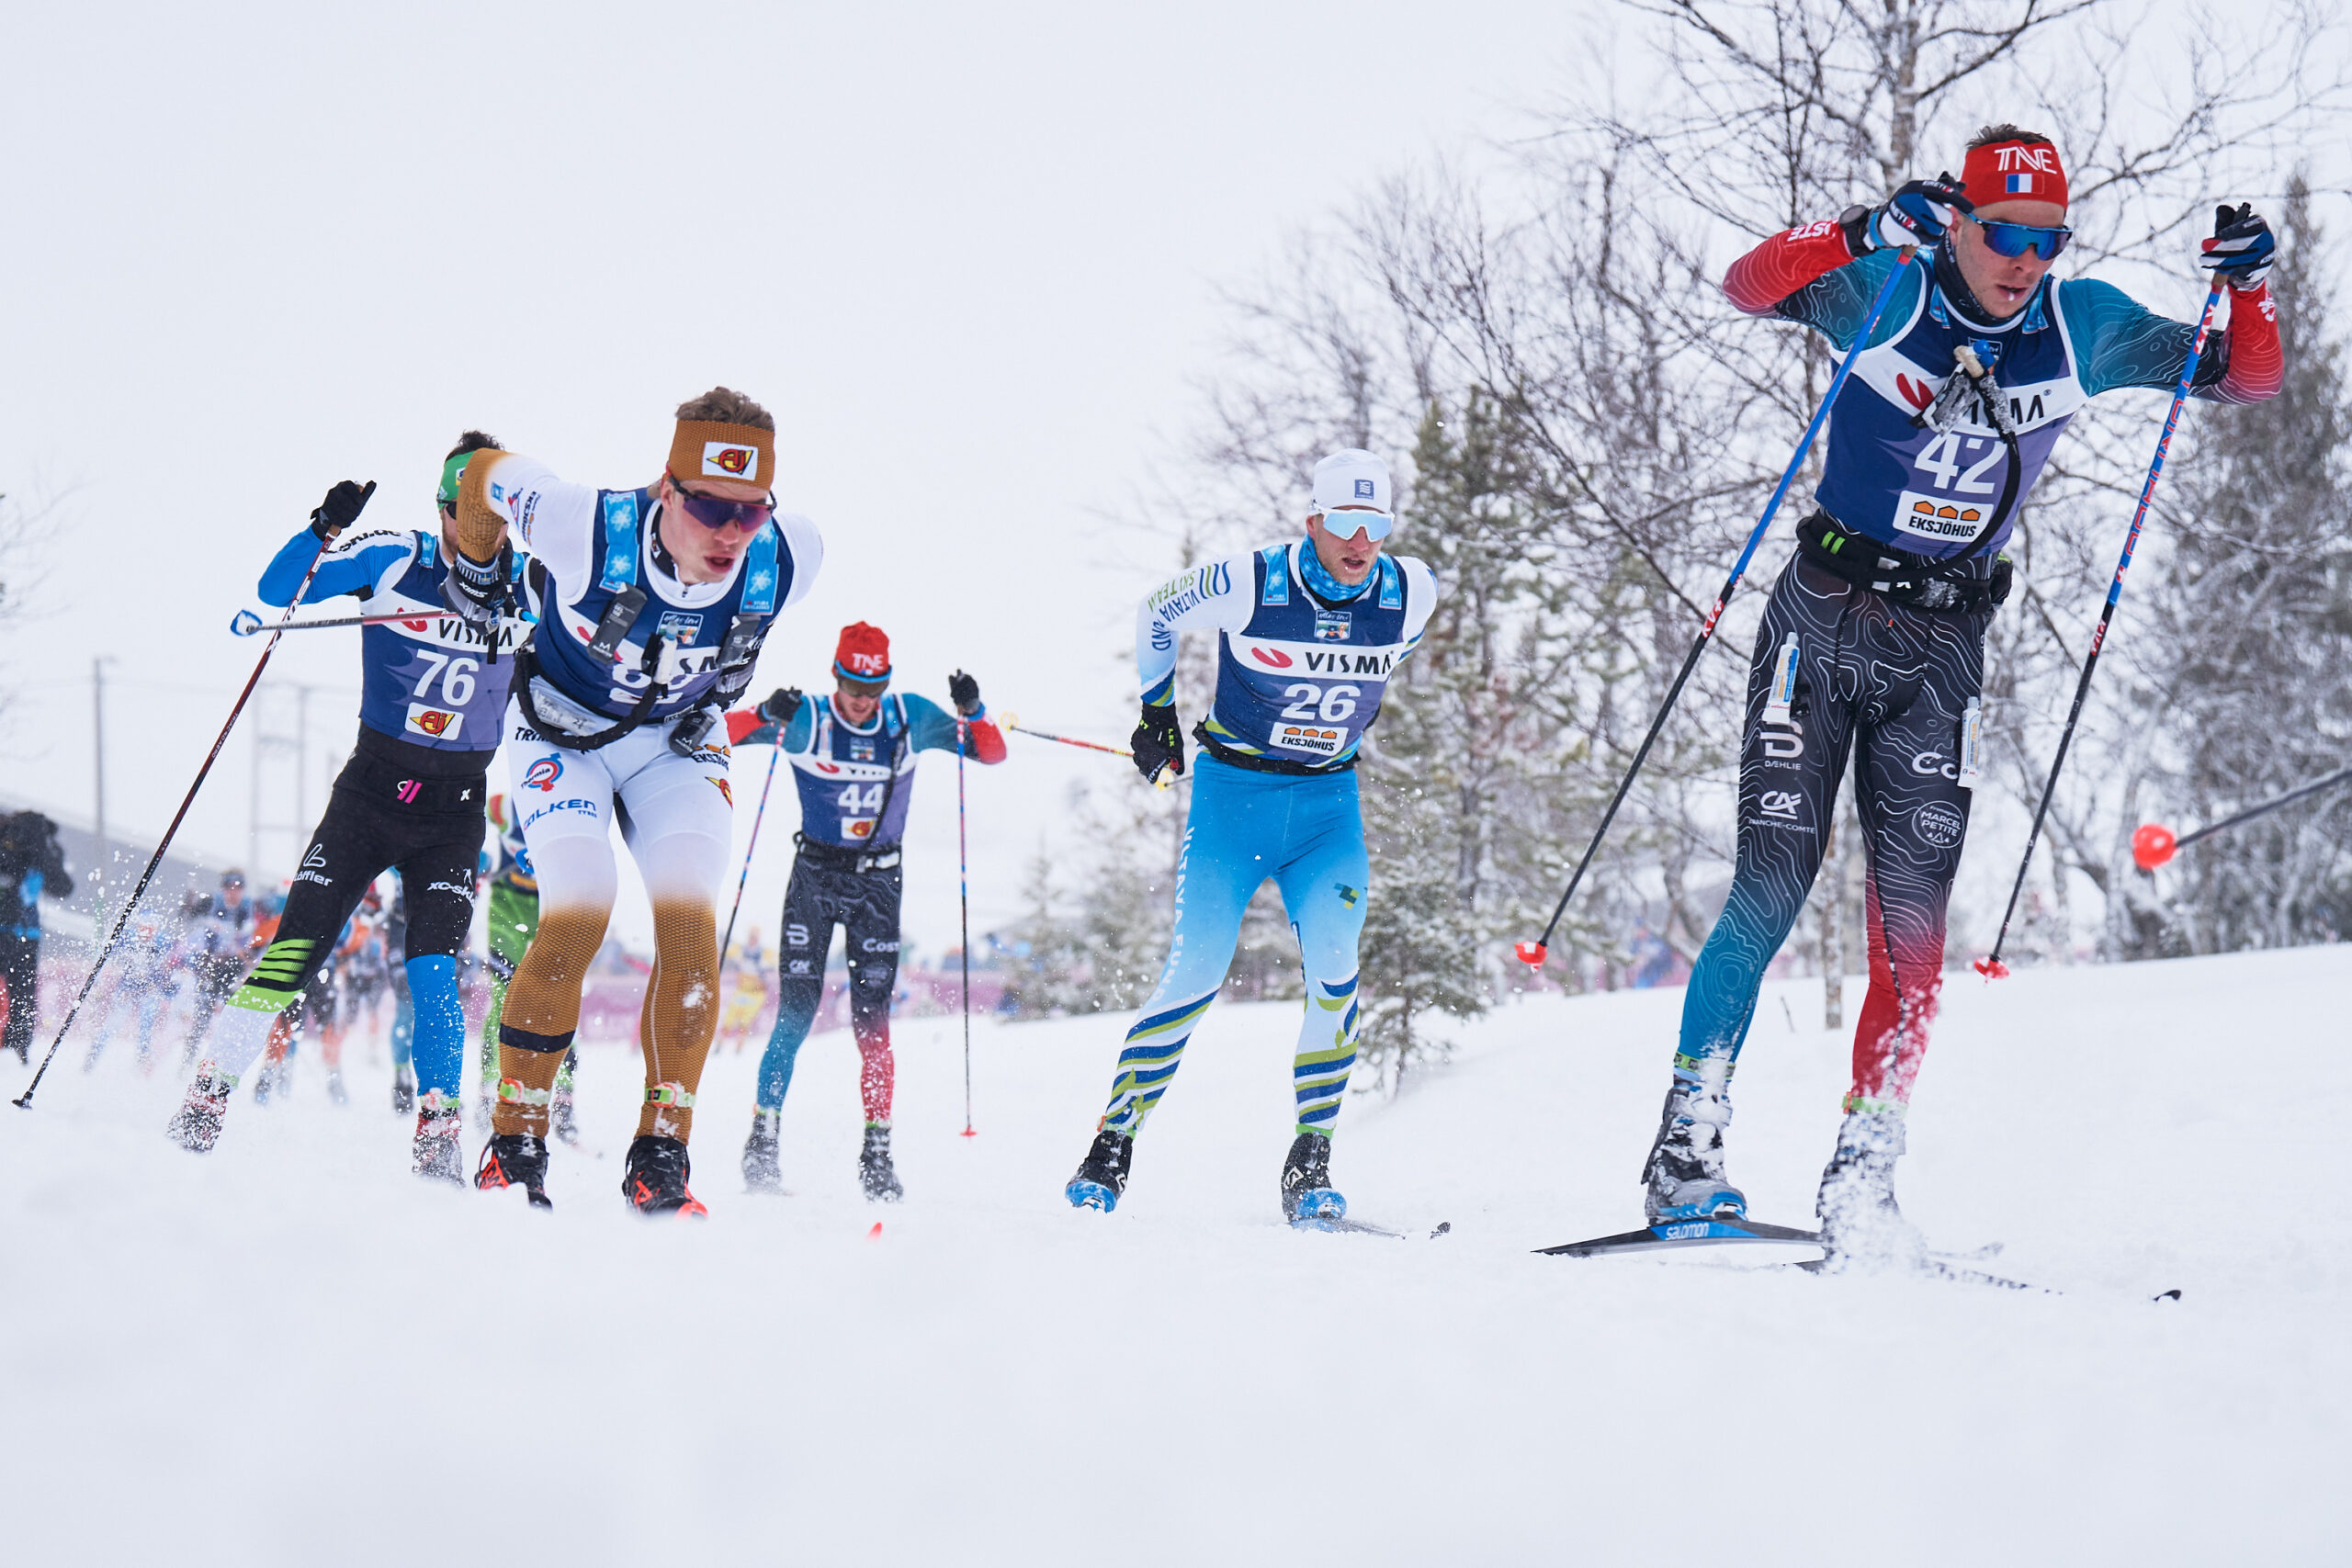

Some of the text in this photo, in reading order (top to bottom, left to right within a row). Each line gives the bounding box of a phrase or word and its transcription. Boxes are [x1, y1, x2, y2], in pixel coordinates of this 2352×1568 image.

[1995, 146, 2057, 174] TNE
[1914, 431, 2008, 494] 42
[1909, 515, 1977, 537] EKSJÖHUS
[1159, 589, 1201, 622] VLTAVA
[1306, 651, 1392, 675] VISMA
[413, 649, 480, 706] 76
[1281, 683, 1361, 722] 26
[1281, 736, 1335, 751] EKSJÖHUS
[838, 784, 884, 815] 44
[1920, 810, 1962, 830] MARCEL
[1921, 820, 1959, 837] PETITE
